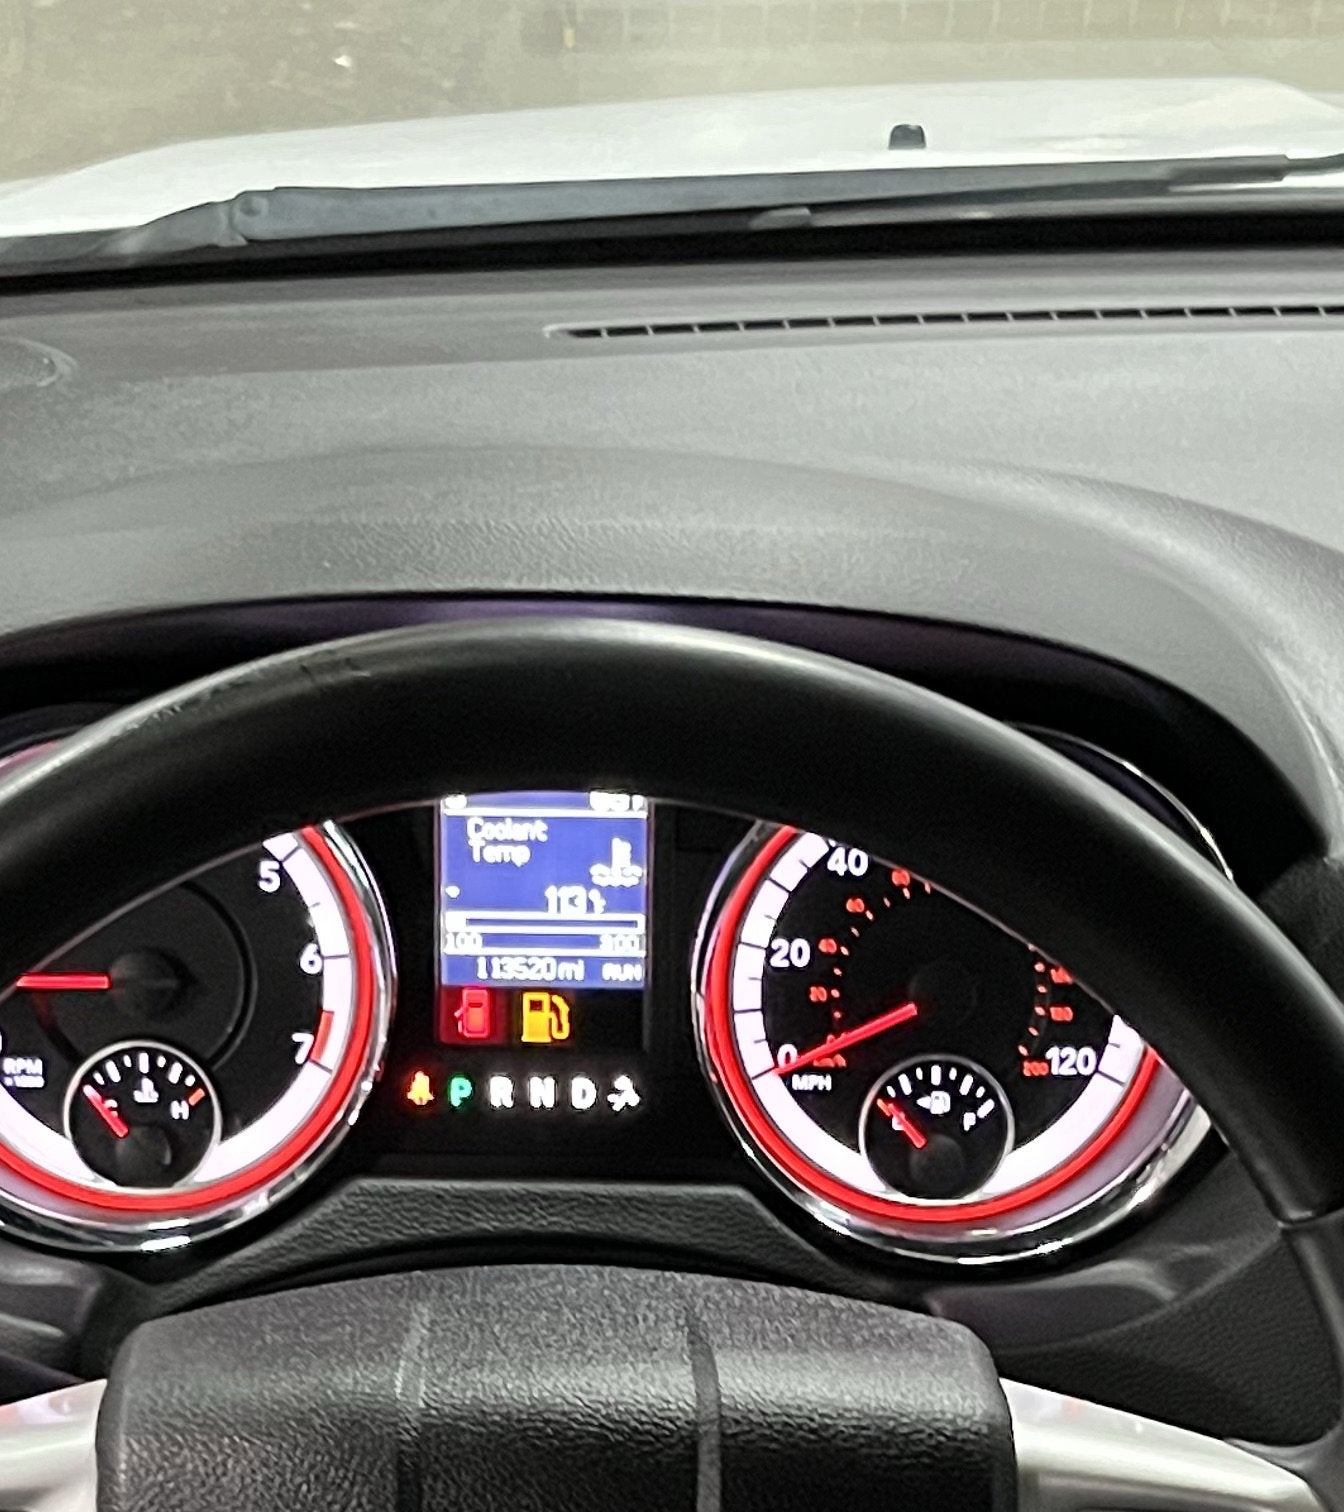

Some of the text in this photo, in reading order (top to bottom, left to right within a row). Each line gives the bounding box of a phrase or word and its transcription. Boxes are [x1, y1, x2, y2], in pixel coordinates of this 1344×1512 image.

[467, 817, 548, 842] Coolant
[468, 838, 531, 867] Temp
[827, 847, 869, 877] 40
[257, 861, 282, 893] 5
[299, 943, 323, 975] 6
[769, 938, 811, 968] 20
[291, 1032, 315, 1064] 7
[1045, 1046, 1097, 1076] 120
[3, 1057, 44, 1075] RPM
[448, 1075, 597, 1109] P R N D
[791, 1073, 833, 1091] MPH
[170, 1099, 190, 1120] H
